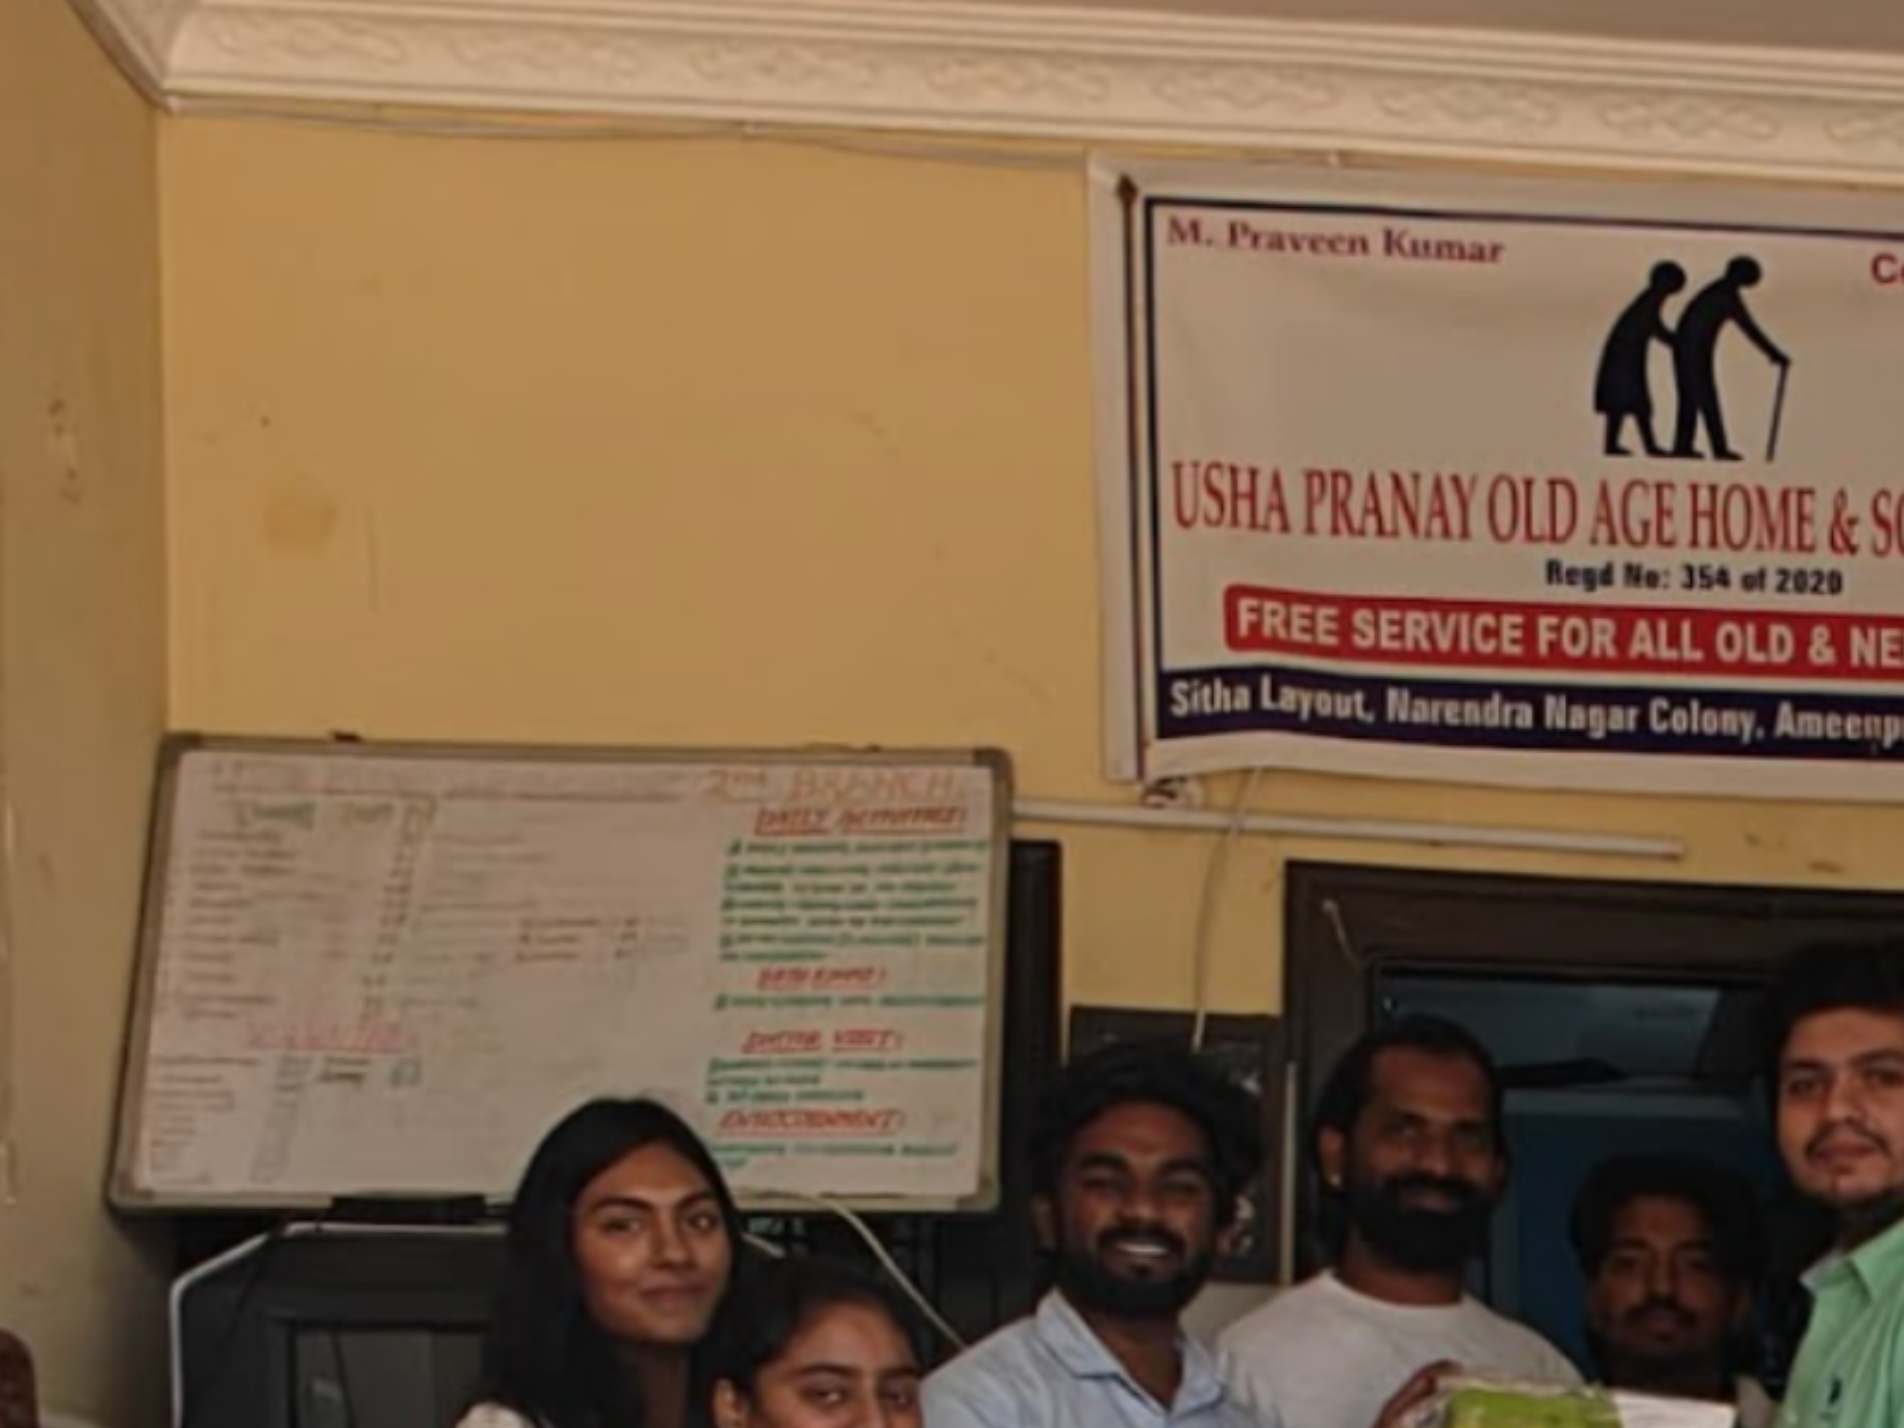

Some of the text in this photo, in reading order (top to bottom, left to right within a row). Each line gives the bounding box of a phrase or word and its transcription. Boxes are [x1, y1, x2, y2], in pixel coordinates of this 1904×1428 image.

[1168, 217, 1504, 264] M. Praveen Kumar
[1171, 461, 1291, 534] USHA
[1302, 467, 1479, 541] PRANAY
[1488, 474, 1577, 546] OLD
[1590, 478, 1676, 548] AGE
[1688, 482, 1816, 555] HOME
[1828, 488, 1860, 556] &
[1546, 559, 1843, 595] Regd No: 354 of 2020
[1237, 598, 1340, 646] FREE
[1351, 608, 1523, 656] SERVICE
[1538, 615, 1617, 658] FOR
[1629, 618, 1702, 662] ALL
[1716, 621, 1794, 664] OLD
[1808, 625, 1836, 666] &
[1171, 678, 1249, 717] Sitha
[1260, 674, 1375, 722] Layout,
[1387, 687, 1533, 729] Narendra
[1545, 694, 1639, 738] Nagar
